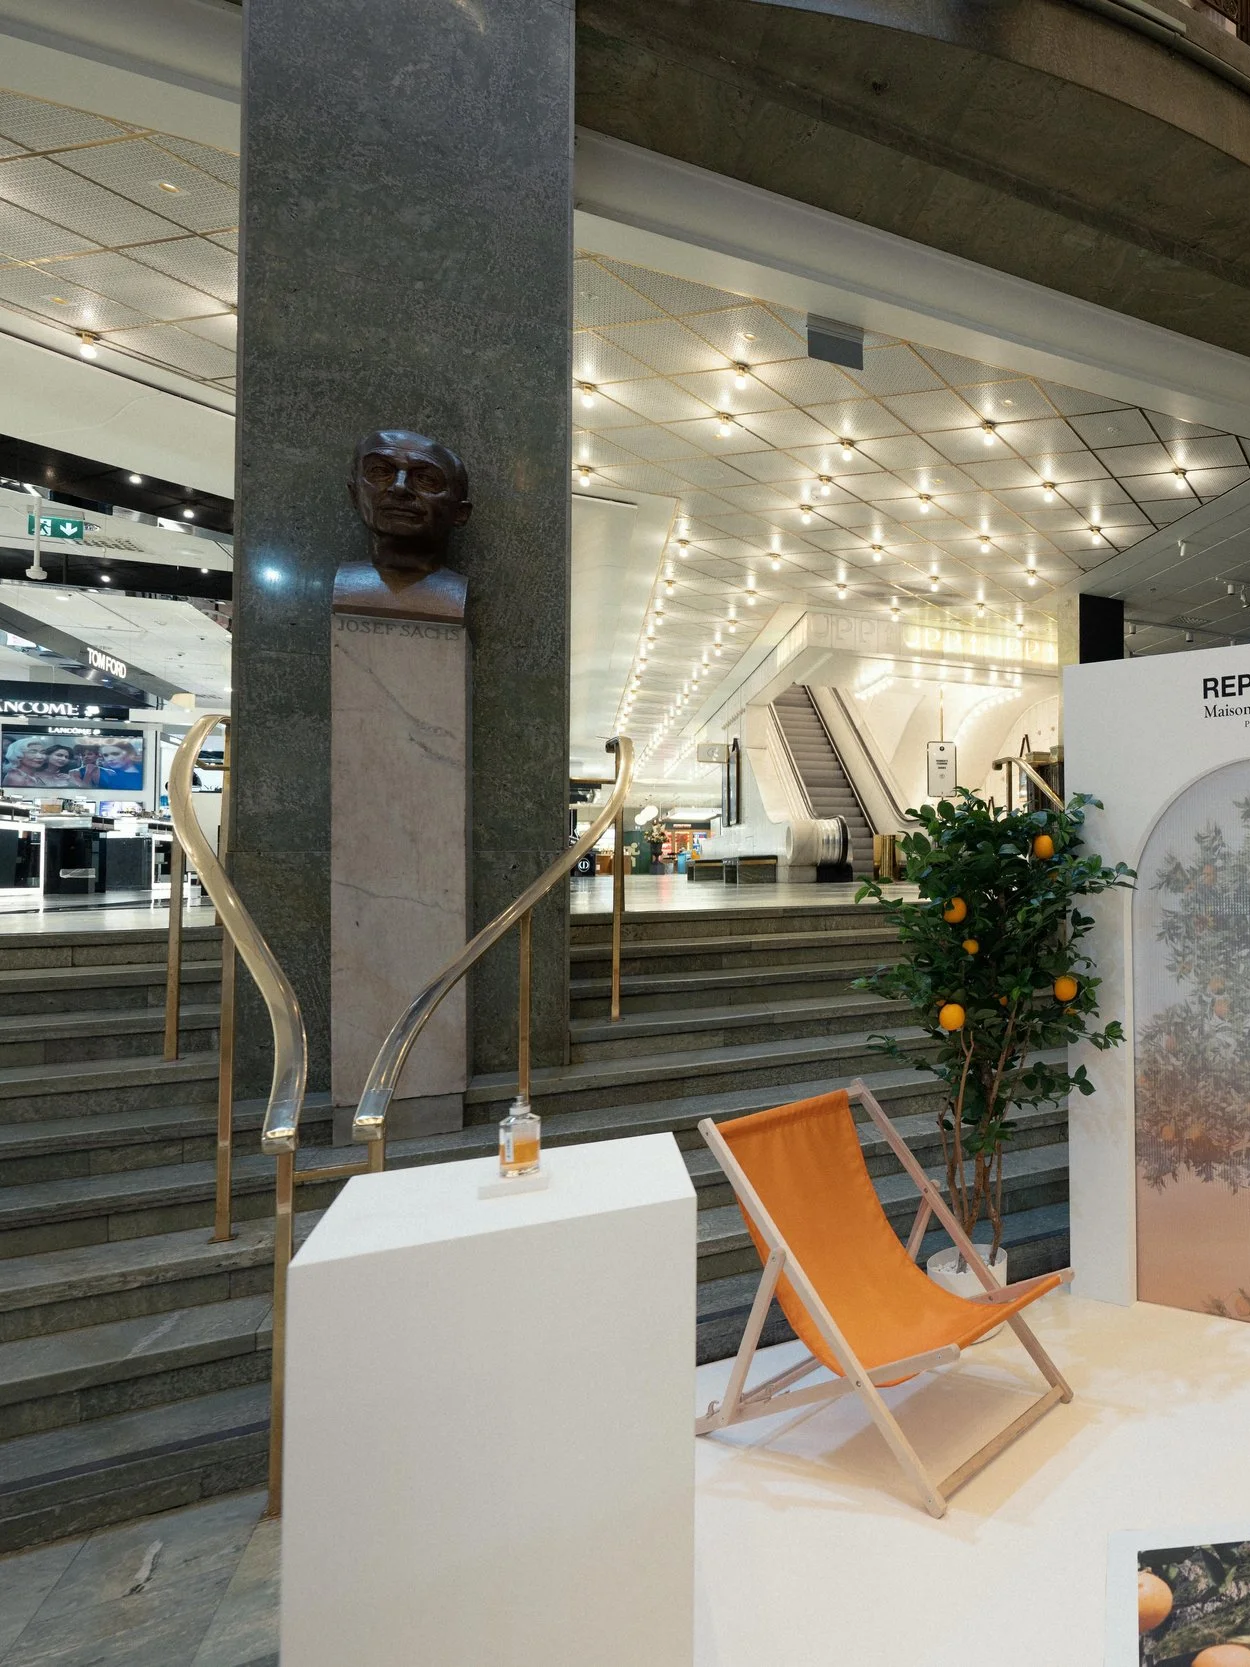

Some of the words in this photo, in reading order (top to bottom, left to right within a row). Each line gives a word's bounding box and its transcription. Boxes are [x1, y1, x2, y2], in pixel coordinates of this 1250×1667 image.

[338, 619, 396, 636] JOSEF
[400, 624, 460, 641] SACHS
[87, 647, 106, 671] TOM
[105, 655, 127, 679] FORD
